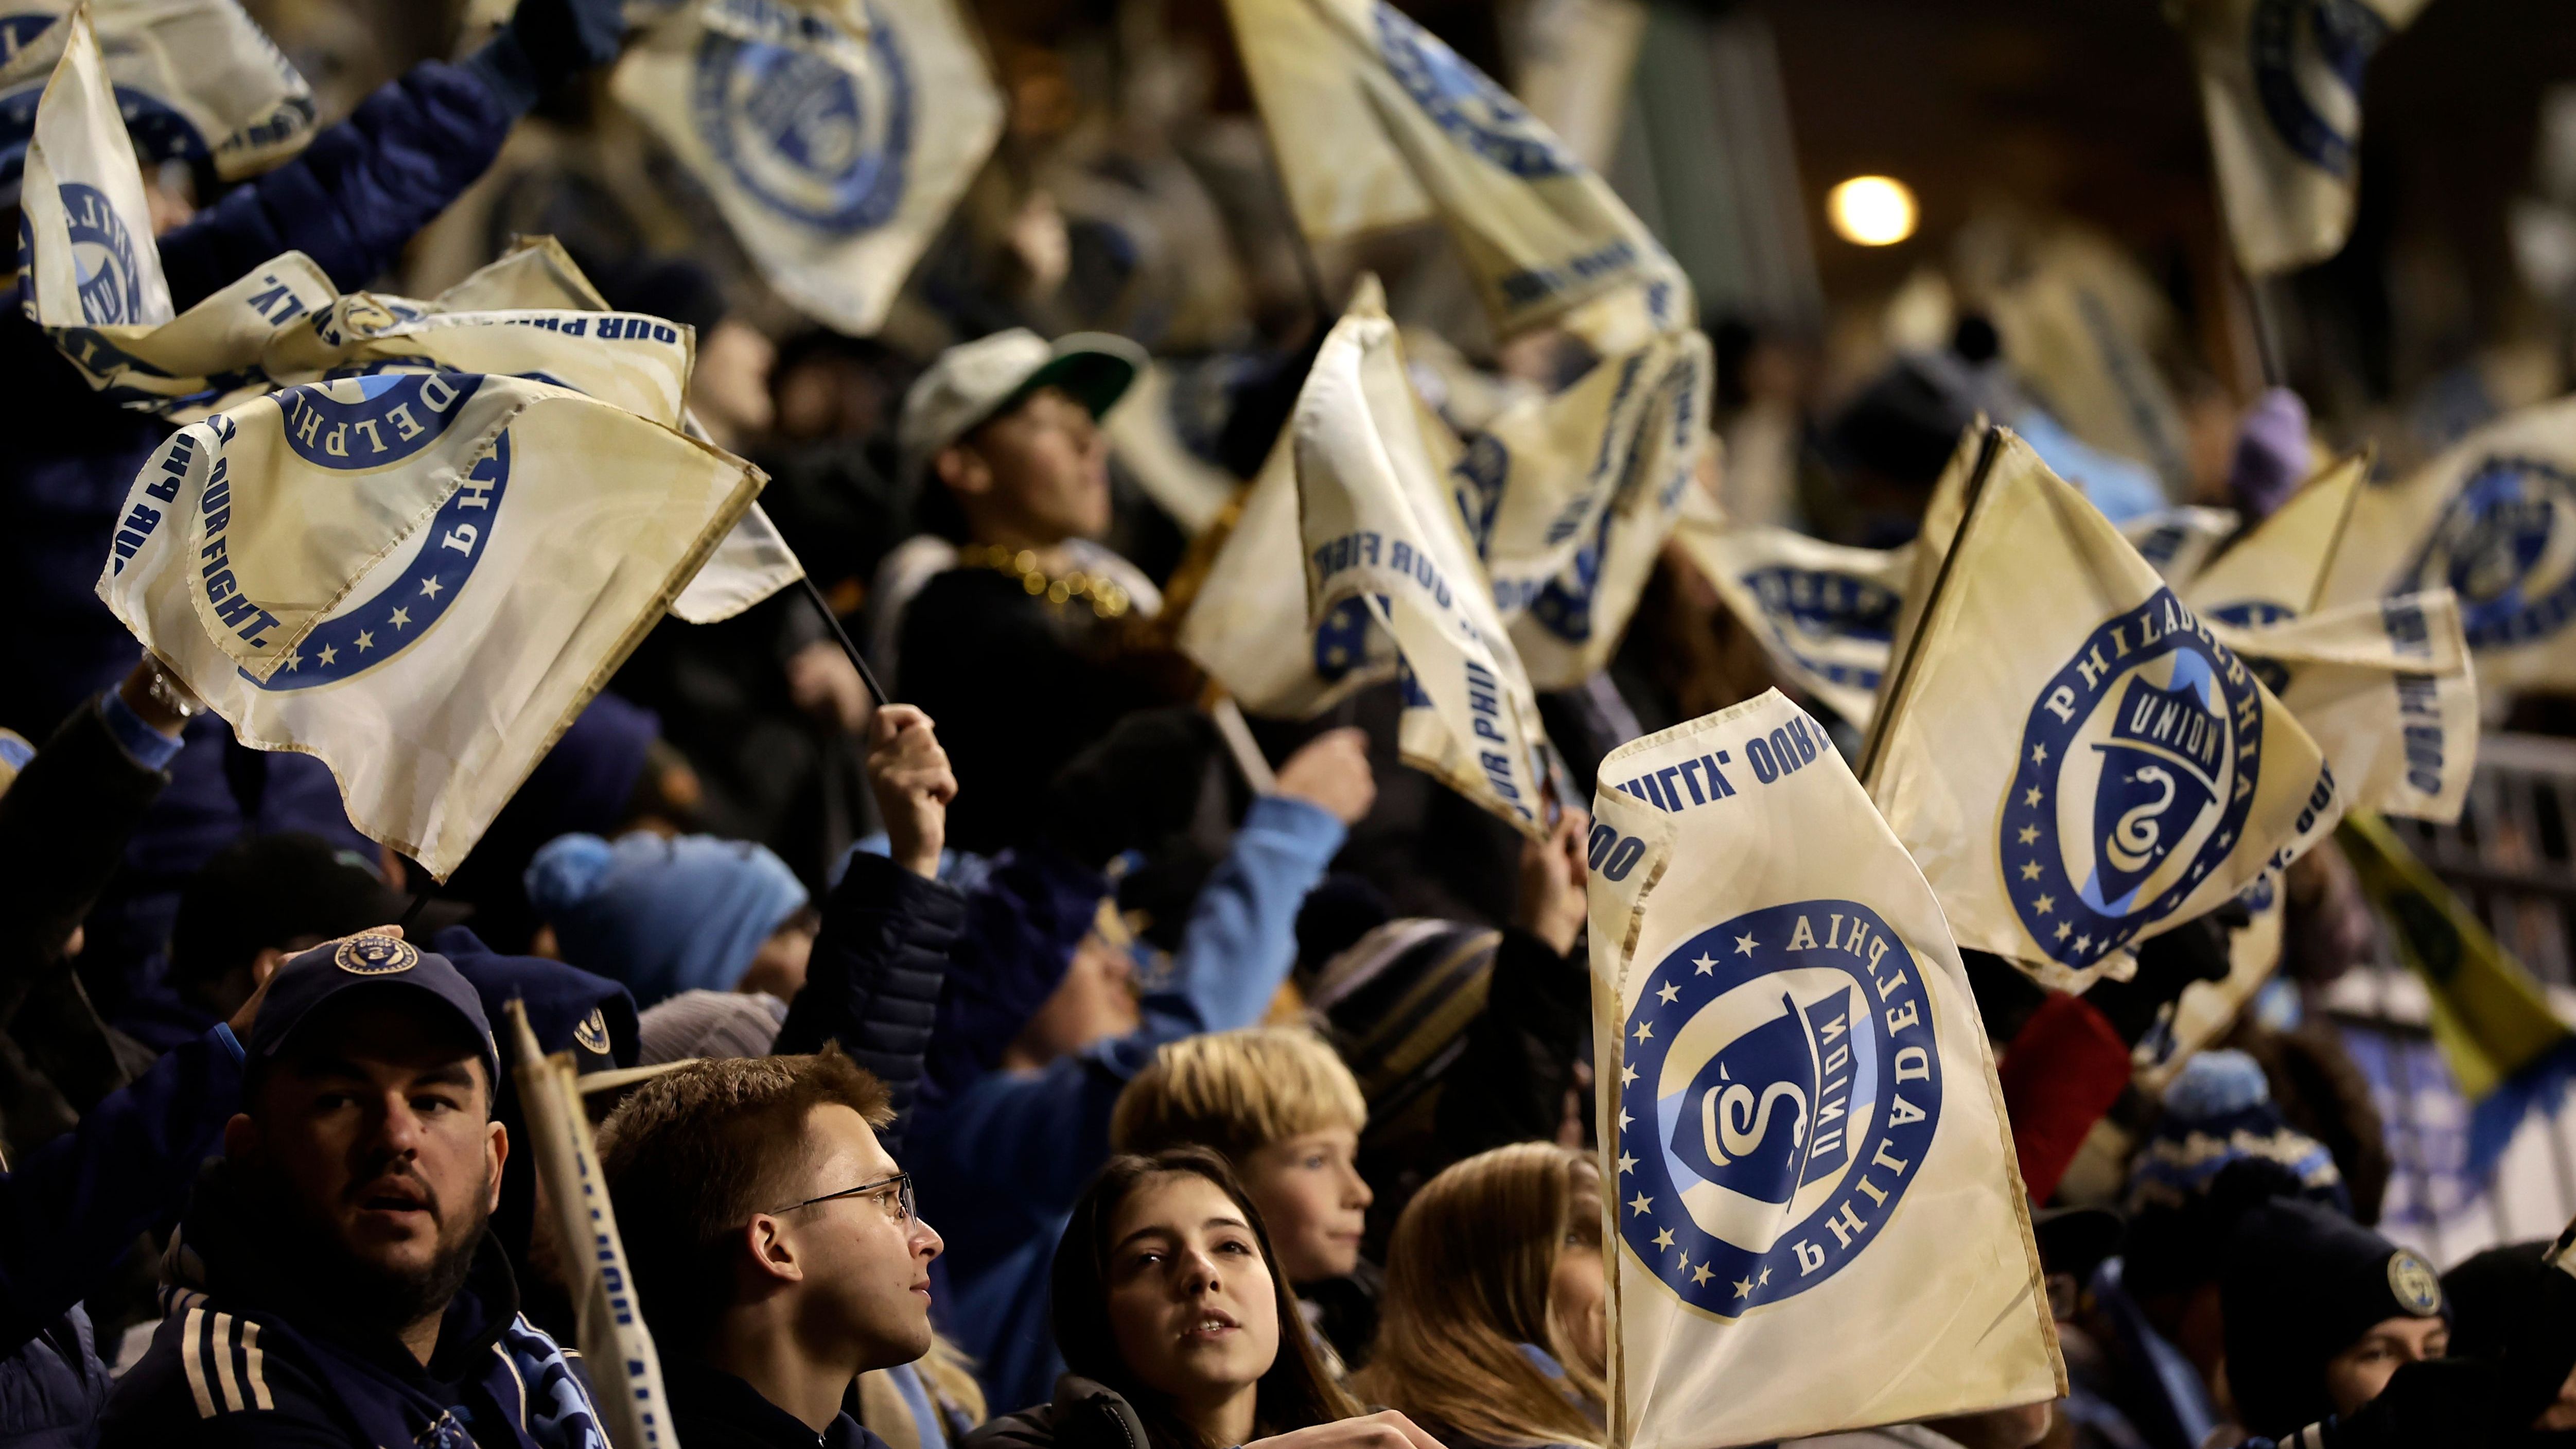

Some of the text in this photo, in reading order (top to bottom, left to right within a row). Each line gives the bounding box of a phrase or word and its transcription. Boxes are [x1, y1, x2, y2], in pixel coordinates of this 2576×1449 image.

[597, 318, 676, 344] OUR
[201, 534, 281, 649] FIGHT.
[2043, 597, 2257, 802] PHILADELPHIA
[2129, 693, 2218, 765] UNION
